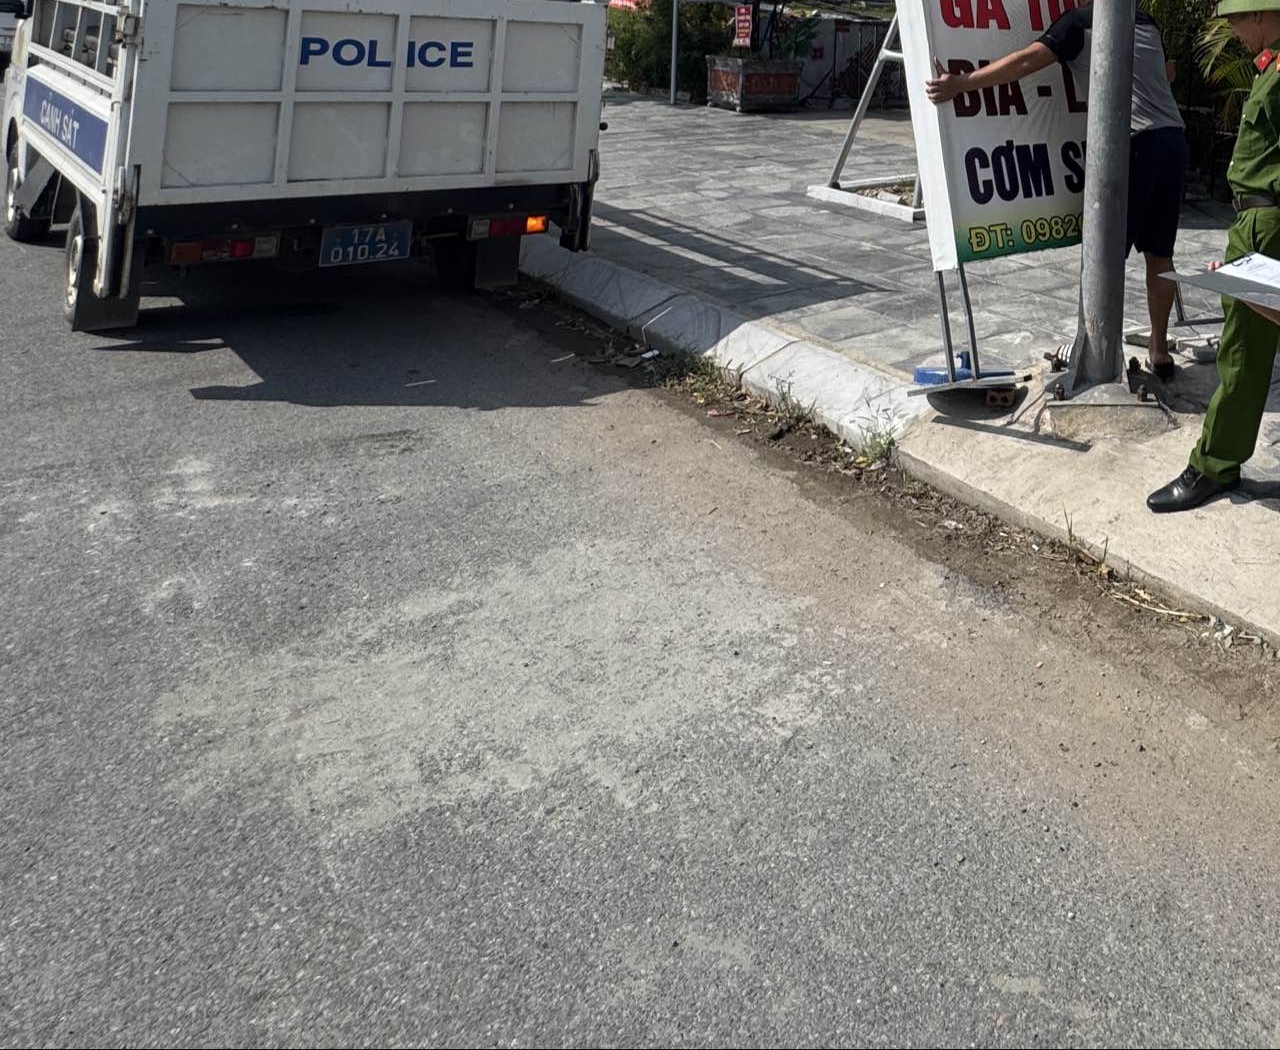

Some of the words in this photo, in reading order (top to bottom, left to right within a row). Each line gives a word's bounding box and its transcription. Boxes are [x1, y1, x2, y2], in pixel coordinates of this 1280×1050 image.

[300, 37, 473, 67] POLICE
[61, 110, 80, 149] SÁT
[965, 139, 1054, 204] CƠM
[1061, 140, 1086, 193] S
[352, 227, 385, 244] 17A
[969, 223, 1014, 253] ĐT:
[1021, 213, 1083, 244] 0982
[330, 241, 399, 262] 010.24
